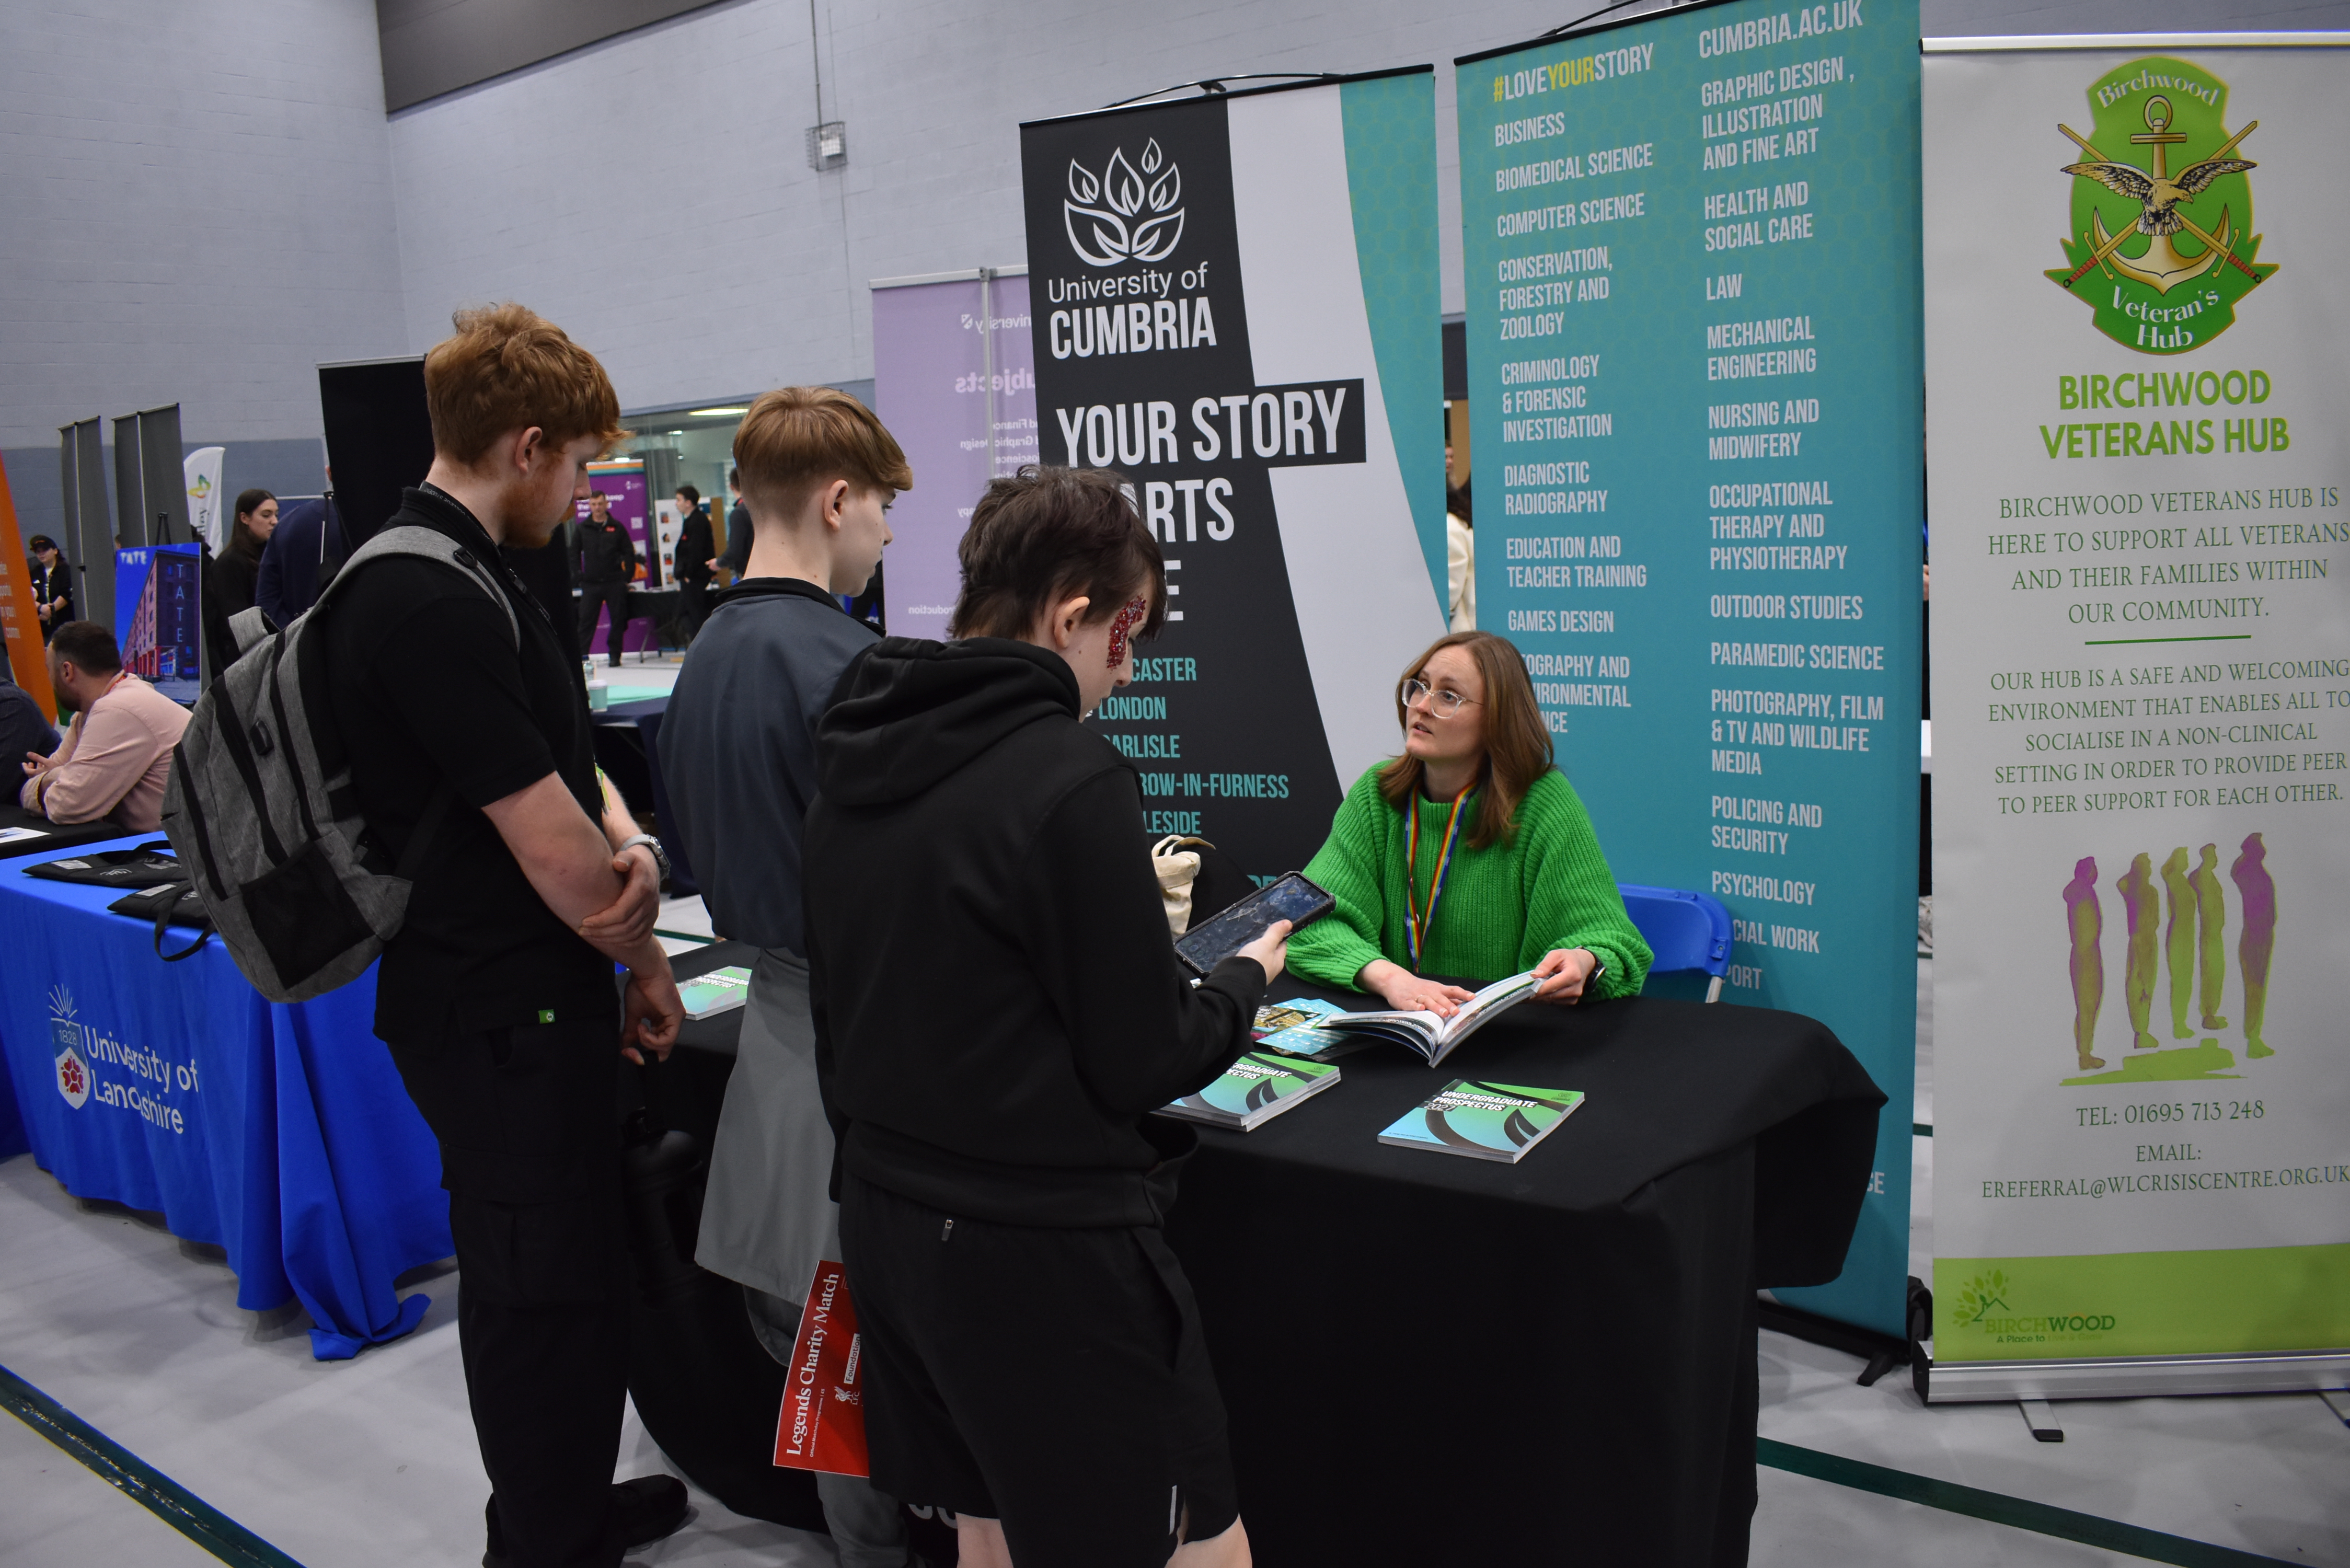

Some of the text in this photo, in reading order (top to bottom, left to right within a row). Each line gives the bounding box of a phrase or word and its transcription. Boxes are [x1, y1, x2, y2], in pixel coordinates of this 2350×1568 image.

[1699, 0, 1863, 59] CUMBRIA.AC.UK
[1493, 42, 1654, 102] #LOVEYOURSTORY
[1701, 56, 1843, 107] GRAPHIC DESIGN
[2096, 69, 2220, 108] Birchwood
[1495, 111, 1565, 147] BUSINESS
[1702, 94, 1823, 139] ILLUSTRATION
[1703, 127, 1819, 171] AND FINE ART
[1496, 143, 1653, 192] BIOMEDICAL SCIENCE
[1497, 192, 1645, 237] COMPUTER SCIENCE
[1704, 181, 1808, 220] HEALTH AND
[1705, 213, 1813, 251] SOCIAL CARE
[1499, 246, 1612, 282] CONSERVATION,
[1049, 261, 1208, 303] University of
[1499, 276, 1609, 312] FORESTRY AND
[1706, 273, 1742, 301] LAW
[2112, 284, 2220, 323] Veteran's
[1050, 296, 1217, 359] CUMBRIA
[1500, 312, 1564, 340] ZOOLOGY
[1707, 316, 1815, 349] MECHANICAL
[2137, 325, 2193, 349] Hub
[1502, 354, 1600, 385] CRIMINOLOGY
[1708, 348, 1816, 381] ENGINEERING
[1503, 385, 1586, 414] & FORENSIC
[2059, 370, 2271, 410] BIRCHWOOD
[1056, 388, 1346, 468] YOUR STORY
[1503, 413, 1612, 443] INVESTIGATION
[1709, 398, 1819, 429] NURSING AND
[1709, 432, 1802, 460] MIDWIFERY
[2039, 418, 2289, 459] VETERANS HUB
[1504, 461, 1589, 487] DIAGNOSTIC
[1120, 478, 1235, 543] RTS
[1505, 490, 1608, 515] RADIOGRAPHY
[1710, 481, 1833, 509] OCCUPATIONAL
[2000, 487, 2338, 518] BIRCHWOOD VETERANS HUB IS
[1709, 513, 1824, 539] THERAPY AND
[1989, 522, 2349, 555] HERE TO SUPPORT ALL VETERANS
[120, 550, 147, 566] TATE
[1506, 536, 1621, 559] EDUCATION AND
[1710, 545, 1848, 570] PHYSIOTHERAPY
[1507, 564, 1646, 587] TEACHER TRAINING
[2011, 559, 2328, 590] AND THEIR FAMILIES WITHIN
[1508, 610, 1614, 632] GAMES DESIGN
[1711, 594, 1863, 620] OUTDOOR STUDIES
[2068, 597, 2269, 624] OUR COMMUNITY.
[1132, 658, 1196, 681] CASTER
[1522, 654, 1630, 678] OGRAPHY AND
[1711, 642, 1884, 670] PARAMEDIC SCIENCE
[1990, 659, 2349, 690] OUR HUB IS A SAFE AND WELCOMING
[1099, 696, 1166, 720] LONDON
[1533, 683, 1631, 707] IRONMENTAL
[1711, 689, 1883, 721] PHOTOGRAPHY, FILM
[1989, 690, 2350, 721] ENVIRONMENT THAT ENABLES ALL TO
[1103, 734, 1180, 758] ARLISLE
[1712, 719, 1870, 752] & TV AND WILDLIFE
[2026, 722, 2318, 752] SOCIALISE IN A NON-CLINICAL
[1712, 749, 1762, 775] MEDIA
[1995, 752, 2347, 783] SETTING IN ORDER TO PROVIDE PEER
[1712, 795, 1822, 828] POLICING AND
[1998, 783, 2343, 814] TO PEER SUPPORT FOR EACH OTHER.
[1143, 811, 1202, 834] LESIDE
[1712, 825, 1789, 855] SECURITY
[1712, 871, 1815, 905] PSYCHOLOGY
[1733, 919, 1819, 954] CIAL WORK
[59, 1029, 77, 1045] 1828
[84, 1025, 199, 1094] University of
[1433, 1097, 1505, 1111] PROSPECTUS
[1441, 1091, 1538, 1108] UNDERGRADUATE
[2076, 1100, 2264, 1126] TEL: 01695 713 248
[2136, 1144, 2201, 1162] EMAIL:
[1983, 1165, 2350, 1199] EREFERRAL@WLCRISISCENTRE.ORG.UK
[1985, 1315, 2116, 1334] BIRCHWOOD
[787, 1274, 839, 1455] Legends Charity Match
[846, 1336, 860, 1381] Foundation
